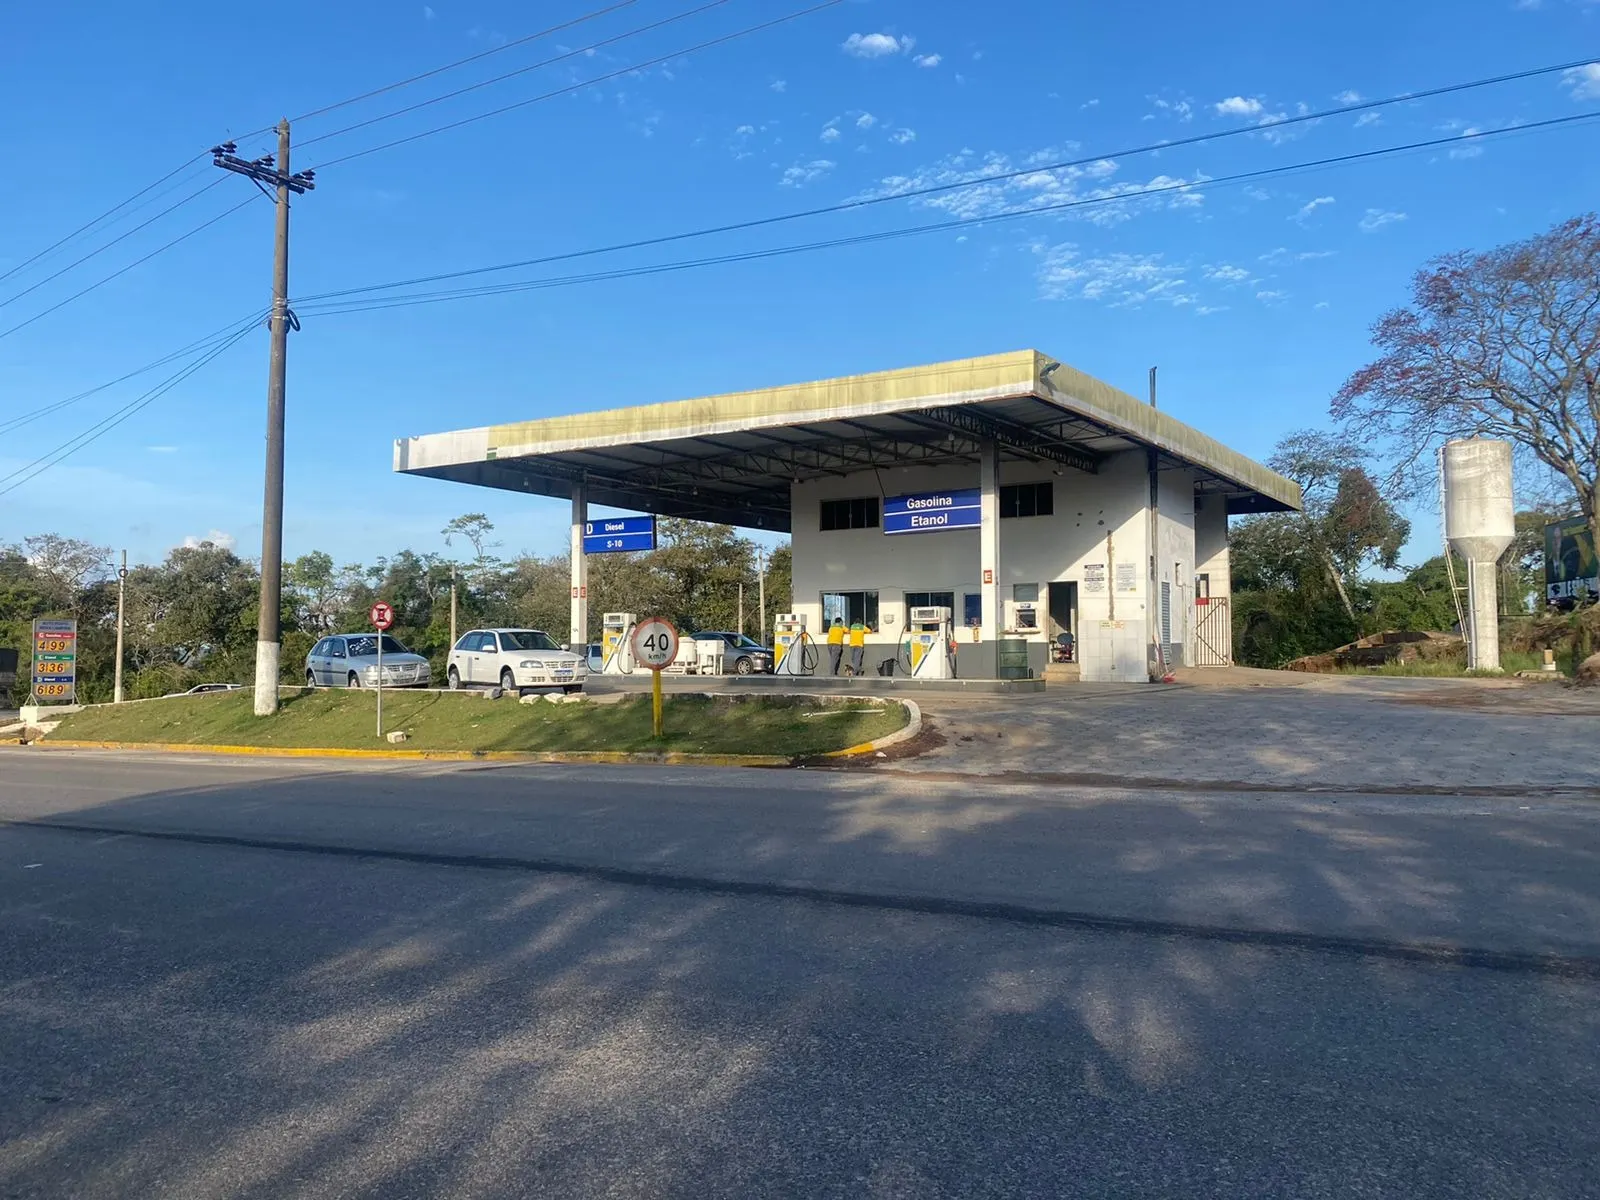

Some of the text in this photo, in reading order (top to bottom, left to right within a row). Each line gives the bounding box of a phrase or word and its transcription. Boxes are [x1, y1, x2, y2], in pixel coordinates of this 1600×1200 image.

[906, 495, 952, 509] Gasolina
[911, 513, 948, 527] Etanol
[586, 522, 624, 535] D Diesel
[607, 539, 623, 548] S-10
[643, 633, 669, 652] 40
